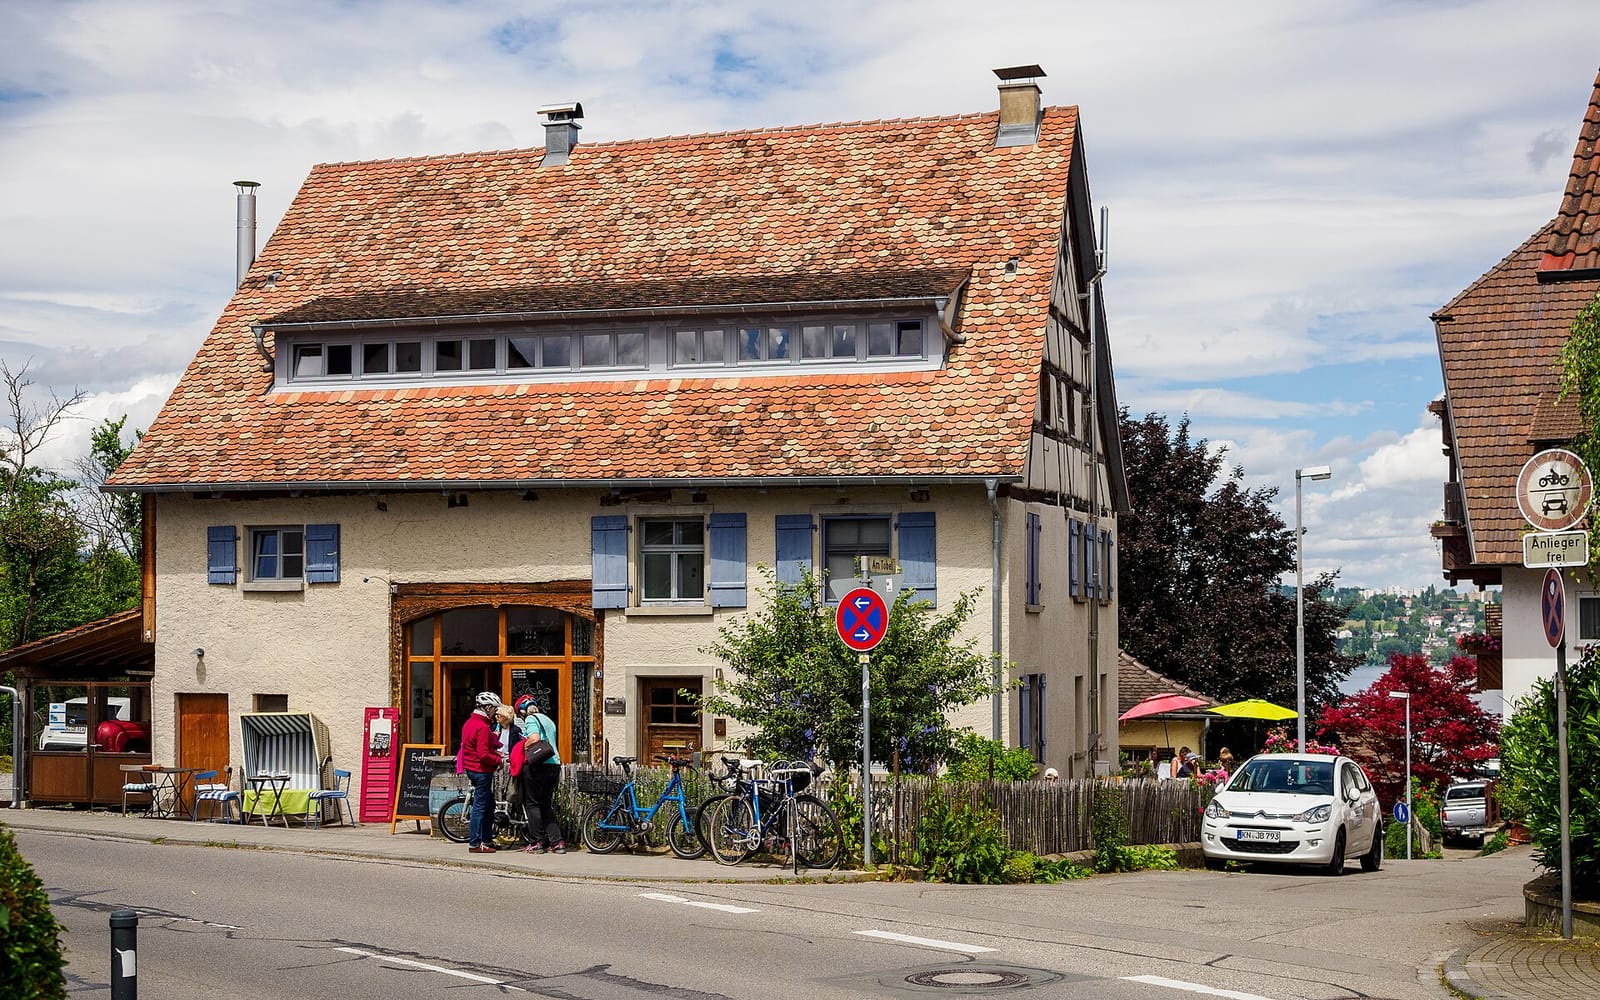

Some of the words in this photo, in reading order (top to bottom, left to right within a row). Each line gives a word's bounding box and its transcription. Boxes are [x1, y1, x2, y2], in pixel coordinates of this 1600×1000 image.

[1531, 538, 1580, 550] Anlieger
[1546, 550, 1566, 562] frei
[872, 560, 880, 569] Am
